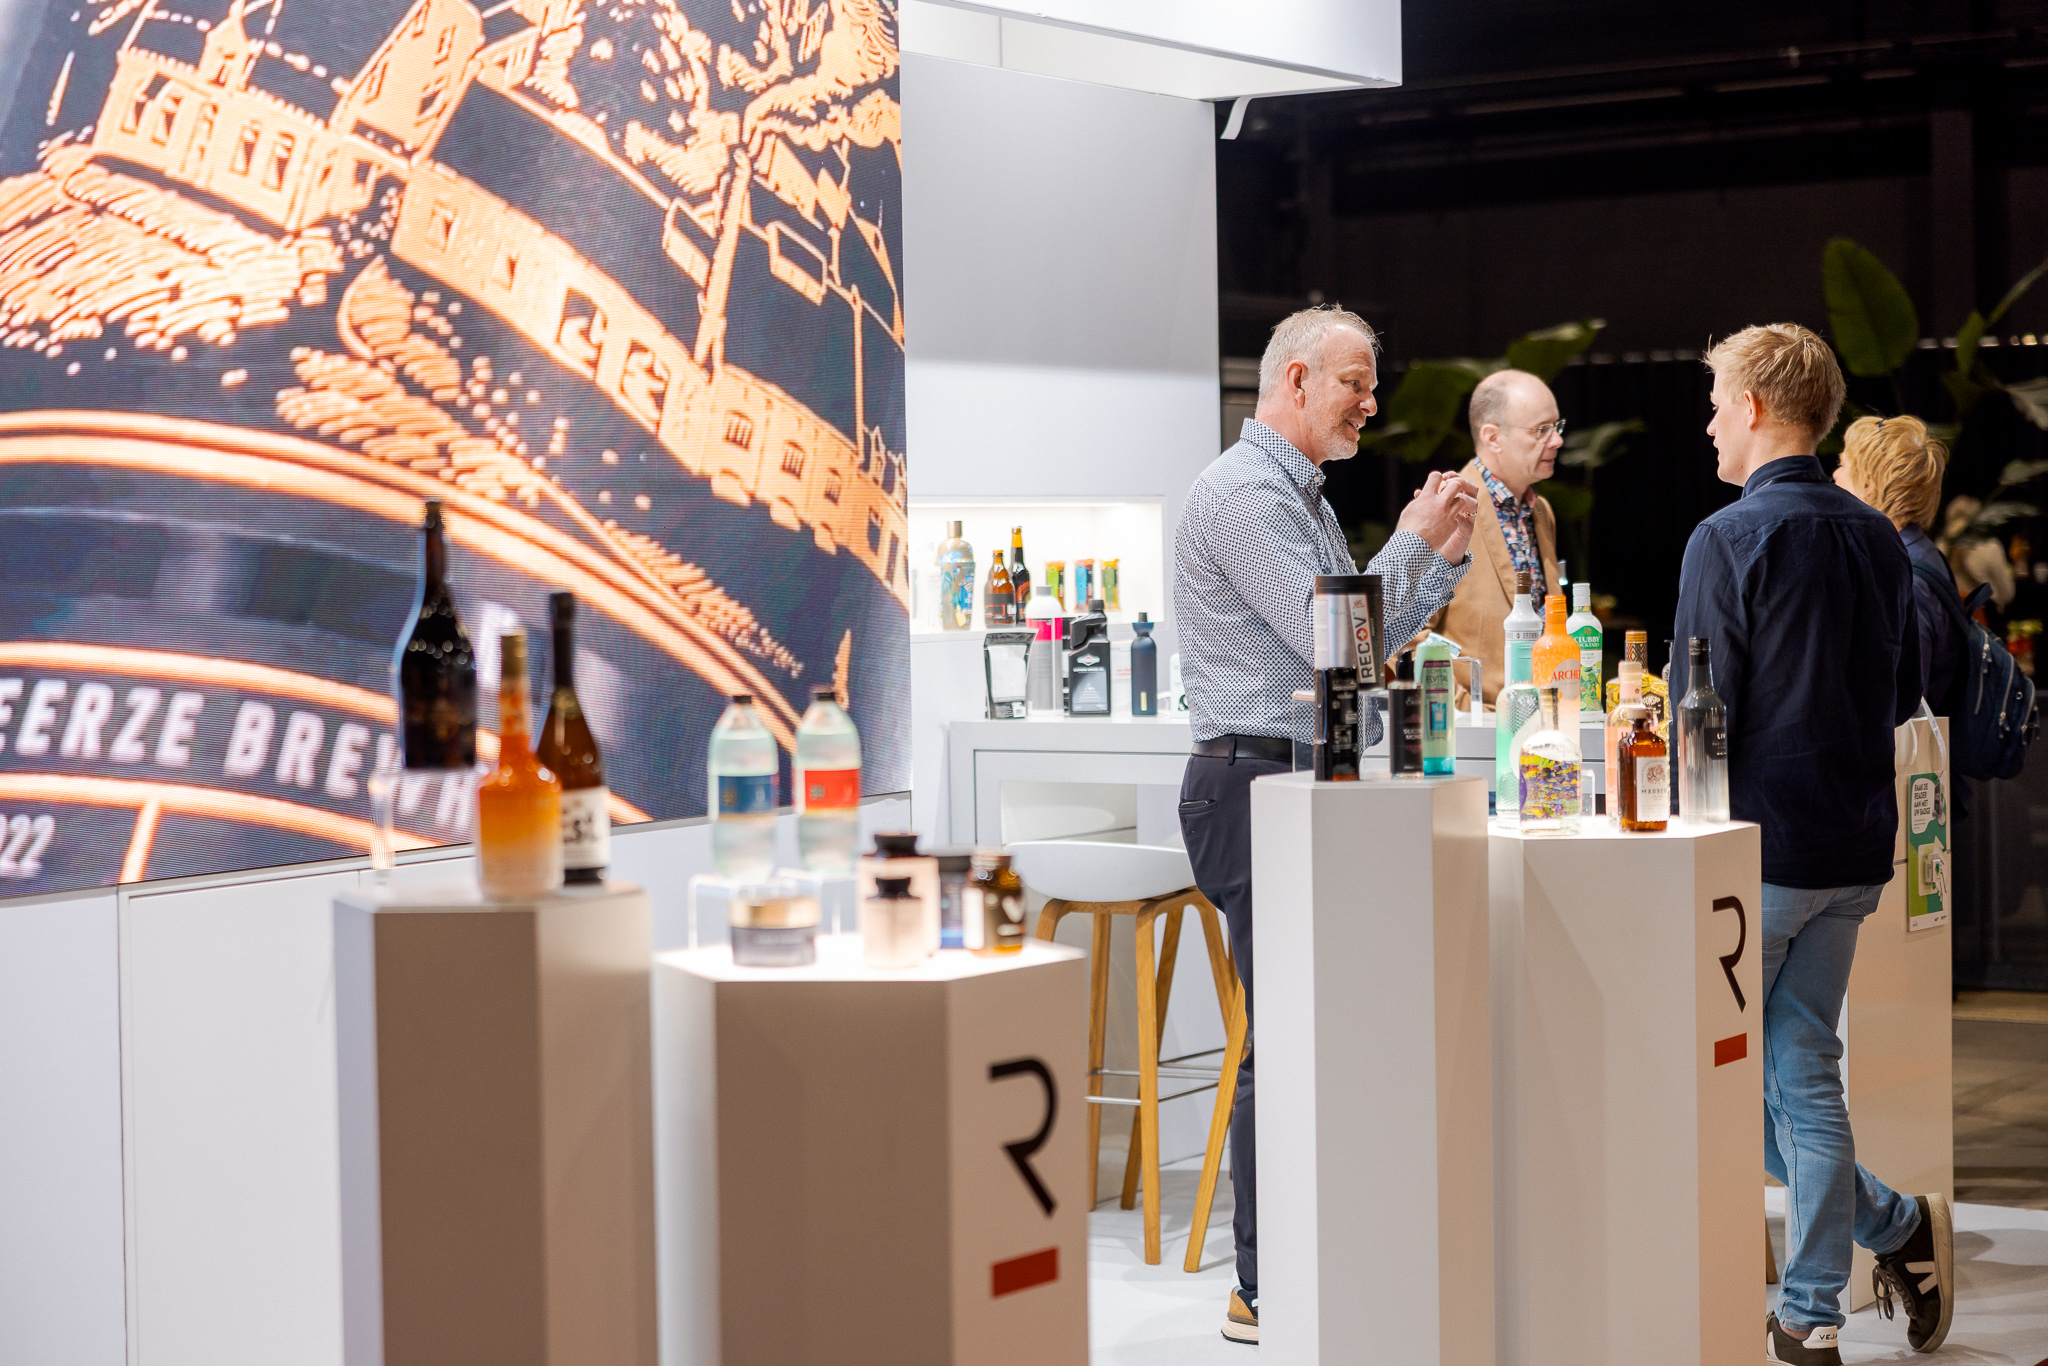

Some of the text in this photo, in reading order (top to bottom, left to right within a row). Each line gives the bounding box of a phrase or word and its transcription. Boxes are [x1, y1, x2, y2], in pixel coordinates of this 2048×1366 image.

[1914, 791, 1927, 799] READER
[1919, 807, 1931, 816] BADGE
[0, 814, 55, 877] 22
